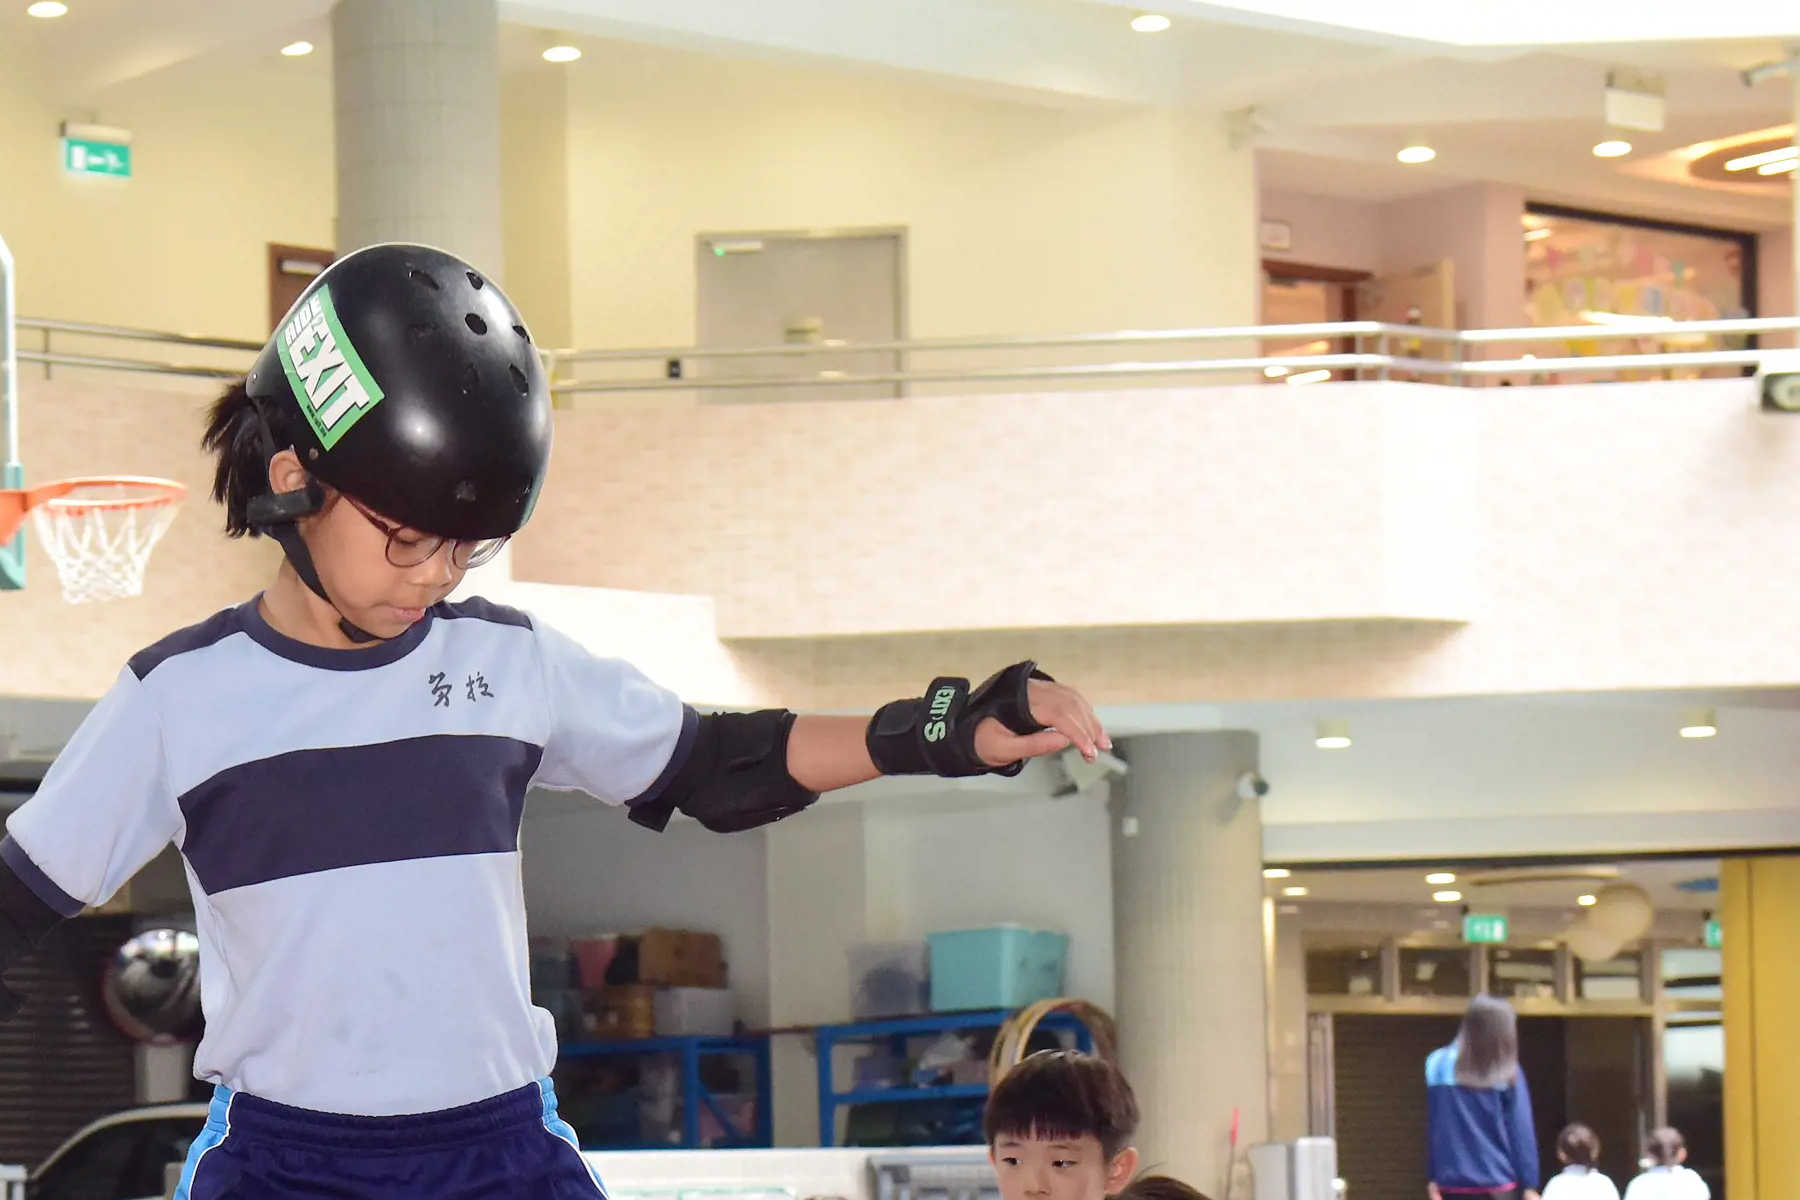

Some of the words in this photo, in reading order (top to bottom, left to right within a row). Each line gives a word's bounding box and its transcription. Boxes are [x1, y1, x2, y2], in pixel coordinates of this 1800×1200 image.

[284, 294, 321, 346] RIDE
[289, 312, 370, 431] EXIT
[924, 721, 946, 742] S
